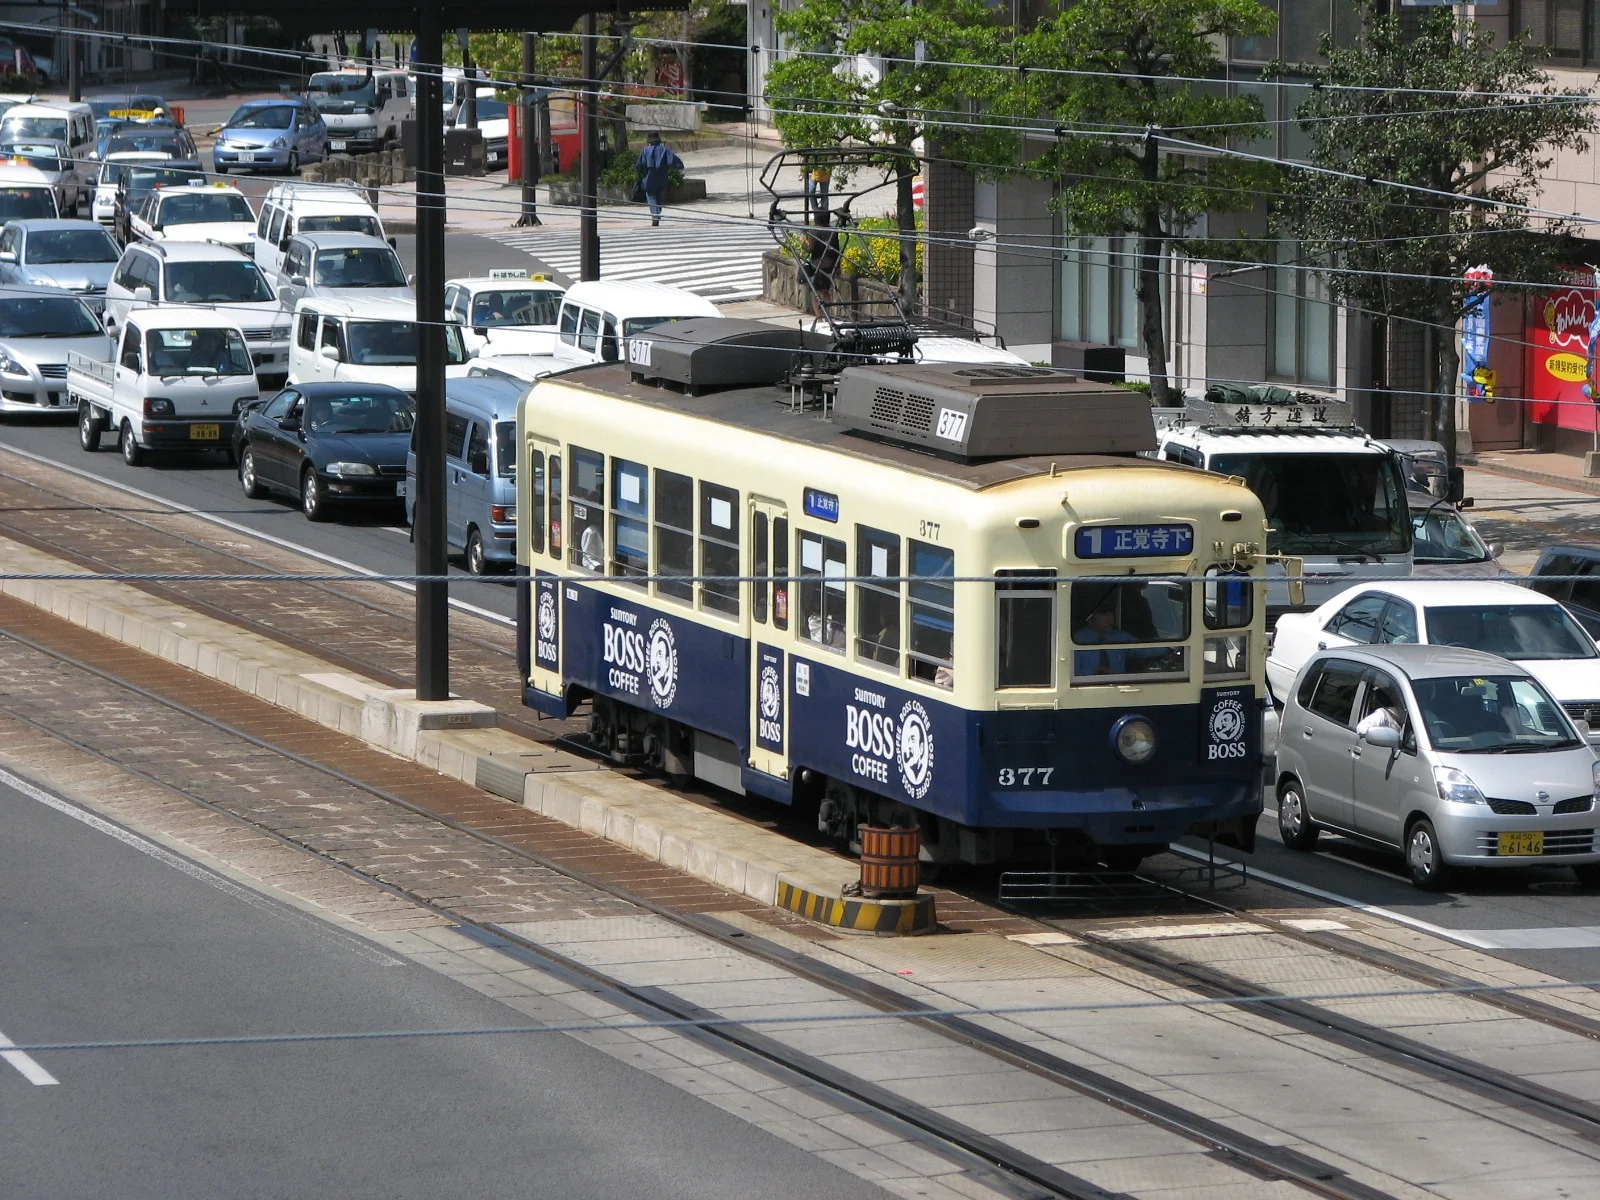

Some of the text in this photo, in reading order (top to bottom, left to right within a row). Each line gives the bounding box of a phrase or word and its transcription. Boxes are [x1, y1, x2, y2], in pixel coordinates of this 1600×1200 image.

[632, 340, 649, 364] 377
[939, 411, 965, 439] 377
[1234, 405, 1328, 424] 緒方運送
[919, 519, 941, 541] 377
[1083, 528, 1190, 554] 1 正覚寺下
[537, 639, 557, 663] BOSS
[603, 623, 645, 673] BOSS
[608, 668, 639, 695] COFFEE
[854, 687, 886, 709] SUNTORY
[1213, 699, 1243, 713] COFFEE
[759, 718, 781, 743] BOSS
[845, 704, 894, 760] BOSS
[1207, 742, 1246, 760] BOSS
[852, 753, 888, 784] COFFEE
[998, 767, 1054, 786] 377
[1508, 841, 1541, 854] 61-46
